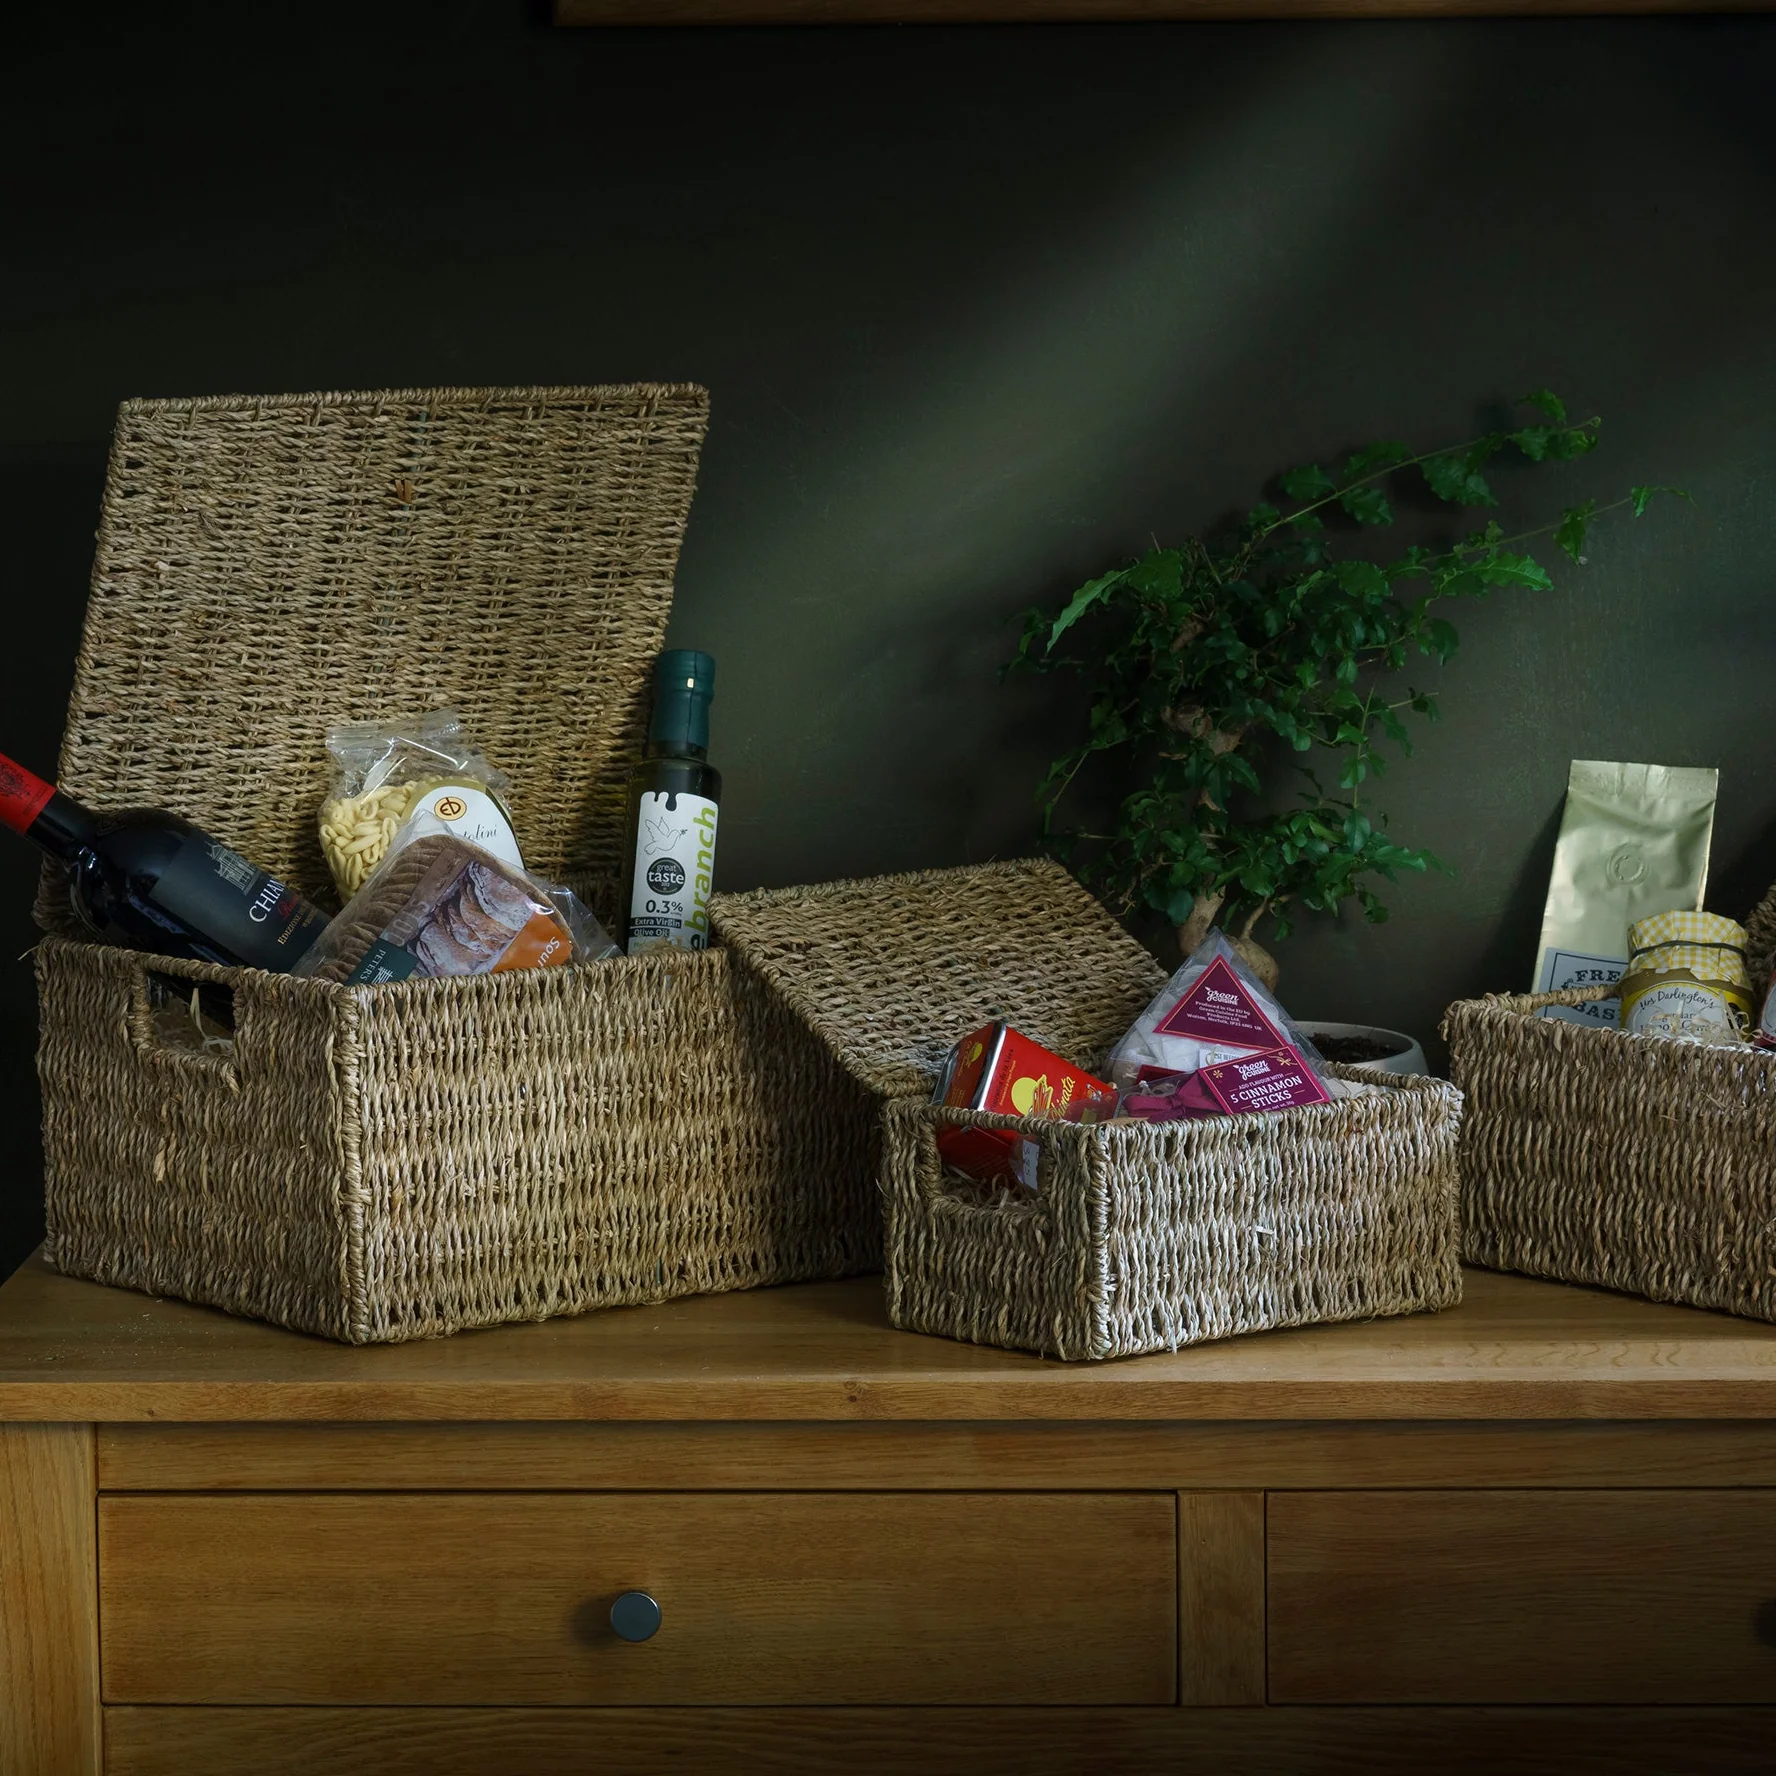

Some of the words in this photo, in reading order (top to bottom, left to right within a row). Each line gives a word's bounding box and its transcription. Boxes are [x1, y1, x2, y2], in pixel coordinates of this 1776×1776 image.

[656, 864, 677, 872] great
[648, 870, 685, 885] taste
[645, 900, 684, 914] 0.3%
[634, 918, 655, 926] Extra
[656, 918, 681, 928] Virgin
[633, 928, 655, 937] Olive
[1657, 987, 1714, 1009] Darlington's
[1238, 1060, 1269, 1081] green
[1249, 1077, 1271, 1088] FLAVOUR
[1271, 1073, 1284, 1081] WITH
[1230, 1093, 1239, 1104] 5
[1239, 1075, 1303, 1100] CINNAMON
[1251, 1090, 1292, 1109] STICKS
